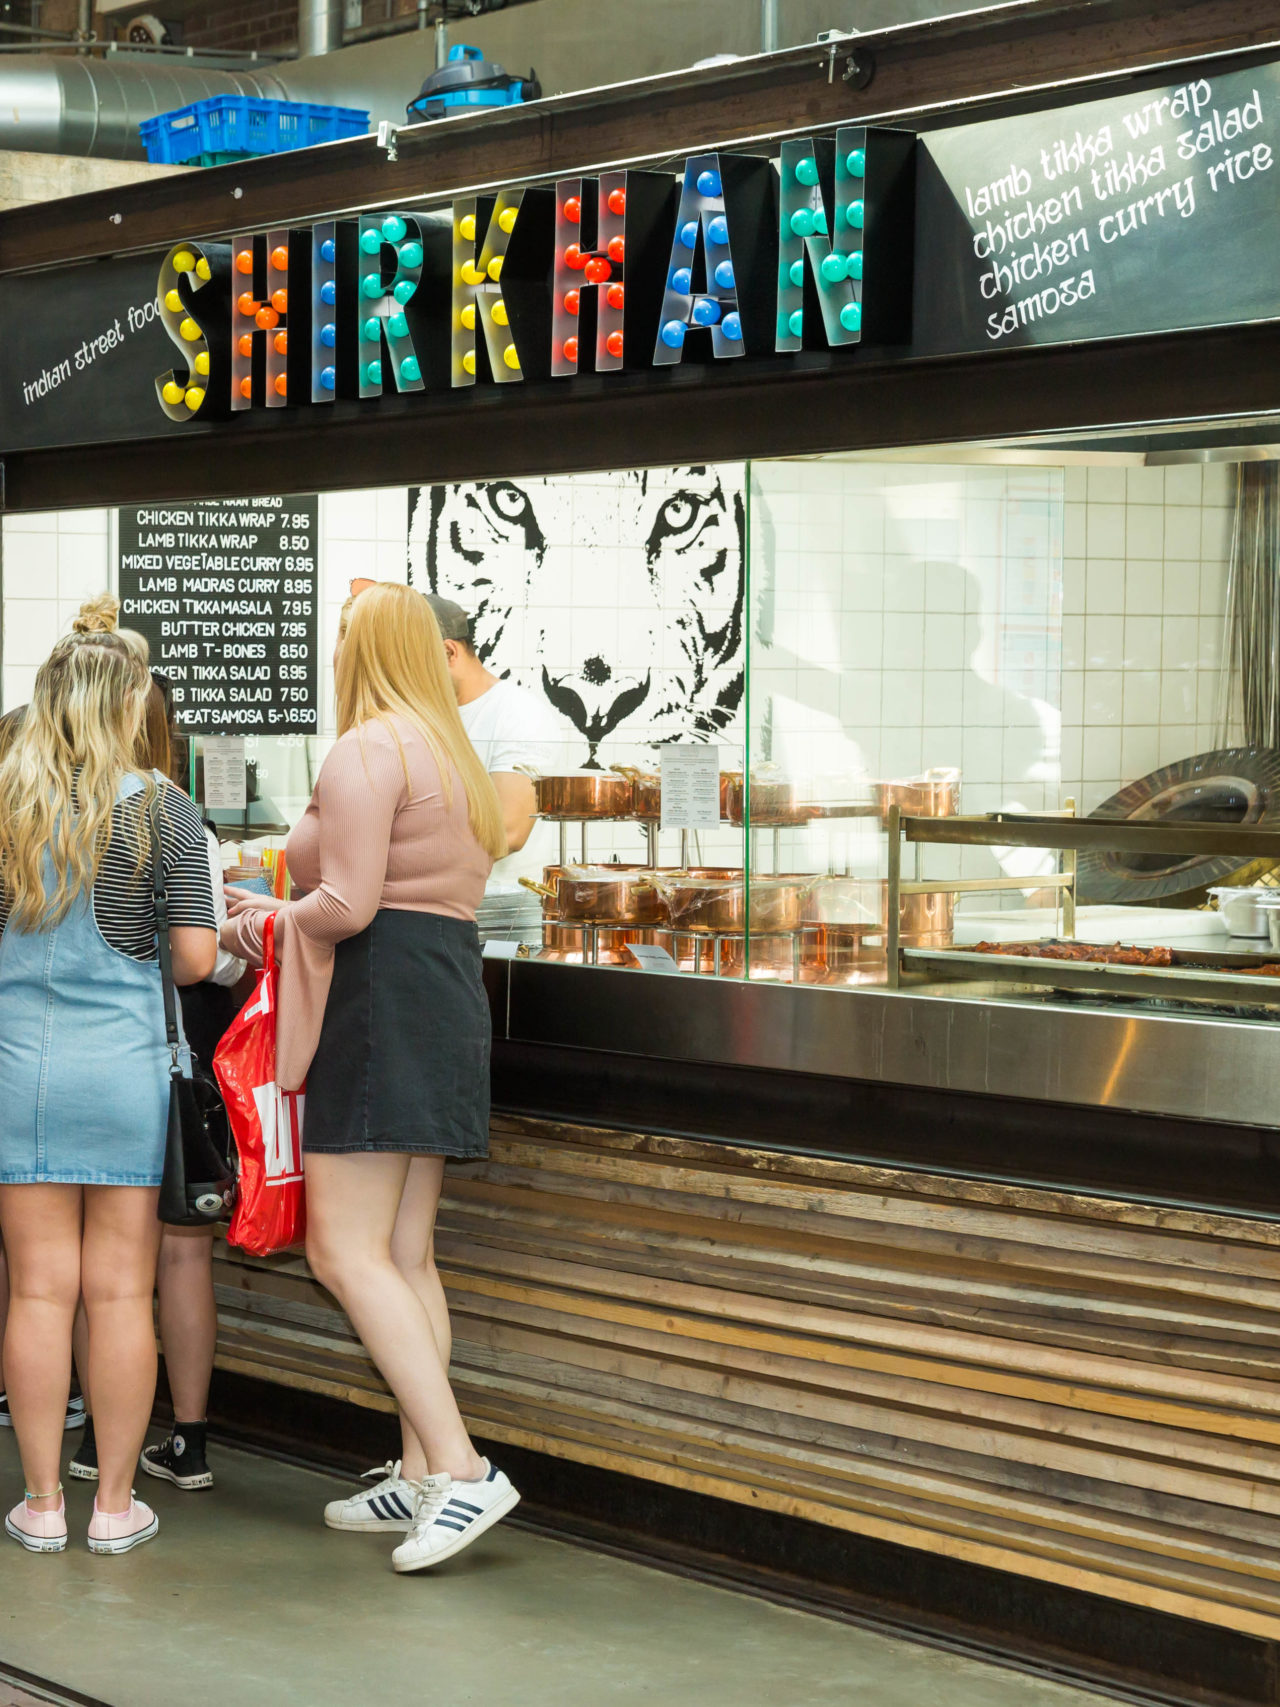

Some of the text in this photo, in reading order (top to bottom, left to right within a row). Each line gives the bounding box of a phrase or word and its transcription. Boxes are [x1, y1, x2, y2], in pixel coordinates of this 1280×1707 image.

[965, 79, 1212, 219] lamb tikka wrap
[973, 89, 1263, 260] chicken tikka salad
[979, 142, 1273, 300] chicken curry rice
[154, 127, 872, 422] SHIRKHAN
[986, 269, 1096, 340] samosa
[23, 359, 71, 406] indian
[75, 319, 124, 370] street
[252, 497, 283, 508] BREAD
[136, 510, 310, 529] CHICKEN TIKKA WRAP 7.95
[138, 533, 310, 551] LAMB TIKKA WRAP 8.50
[121, 553, 314, 572] MIXED VEGETABLE CURRY 6.95
[139, 577, 177, 592] LAMB
[183, 578, 235, 593] MADRAS
[238, 579, 280, 593] CURRY
[123, 599, 312, 616] CHICKEN TIKKA MASALA 7.95
[161, 621, 307, 637] BUTTER CHICKEN 7.95
[161, 643, 198, 659] LAMB
[192, 665, 227, 681] TIKKA
[229, 665, 271, 681] SALAD
[279, 665, 308, 681] 6.95
[190, 687, 226, 702] TIKKA
[229, 687, 272, 702] SALAD
[211, 709, 264, 724] SAMOSA
